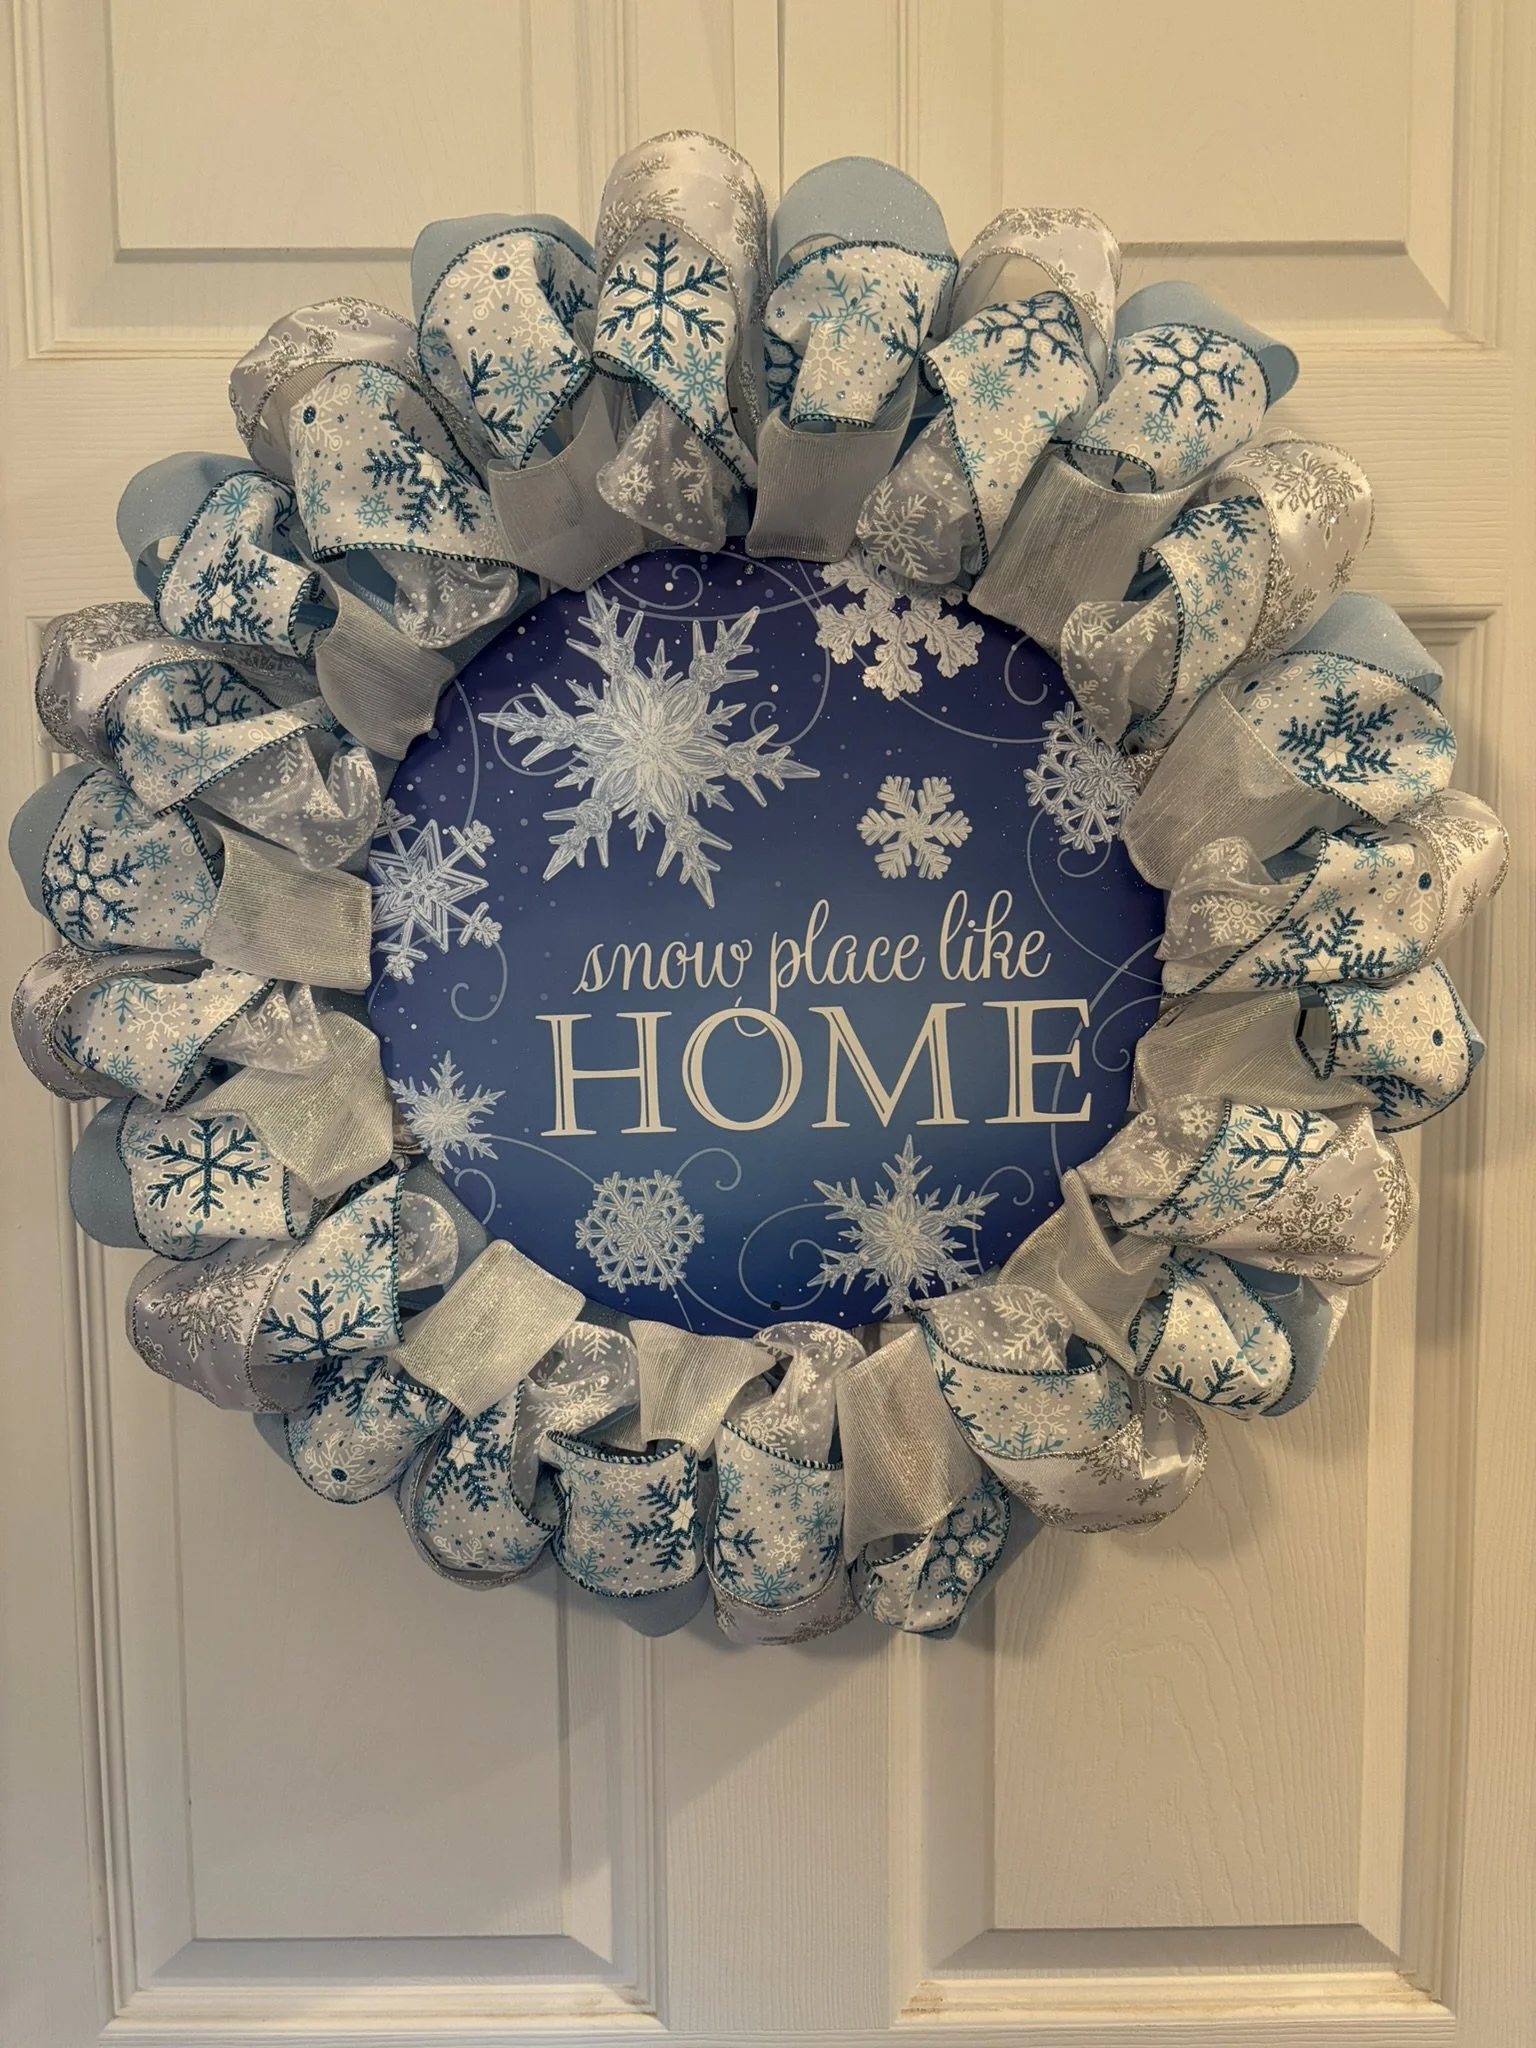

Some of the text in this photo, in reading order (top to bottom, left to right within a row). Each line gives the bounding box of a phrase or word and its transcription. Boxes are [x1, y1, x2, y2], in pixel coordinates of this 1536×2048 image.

[572, 889, 1052, 1037] snow place like
[535, 998, 1092, 1137] HOME
